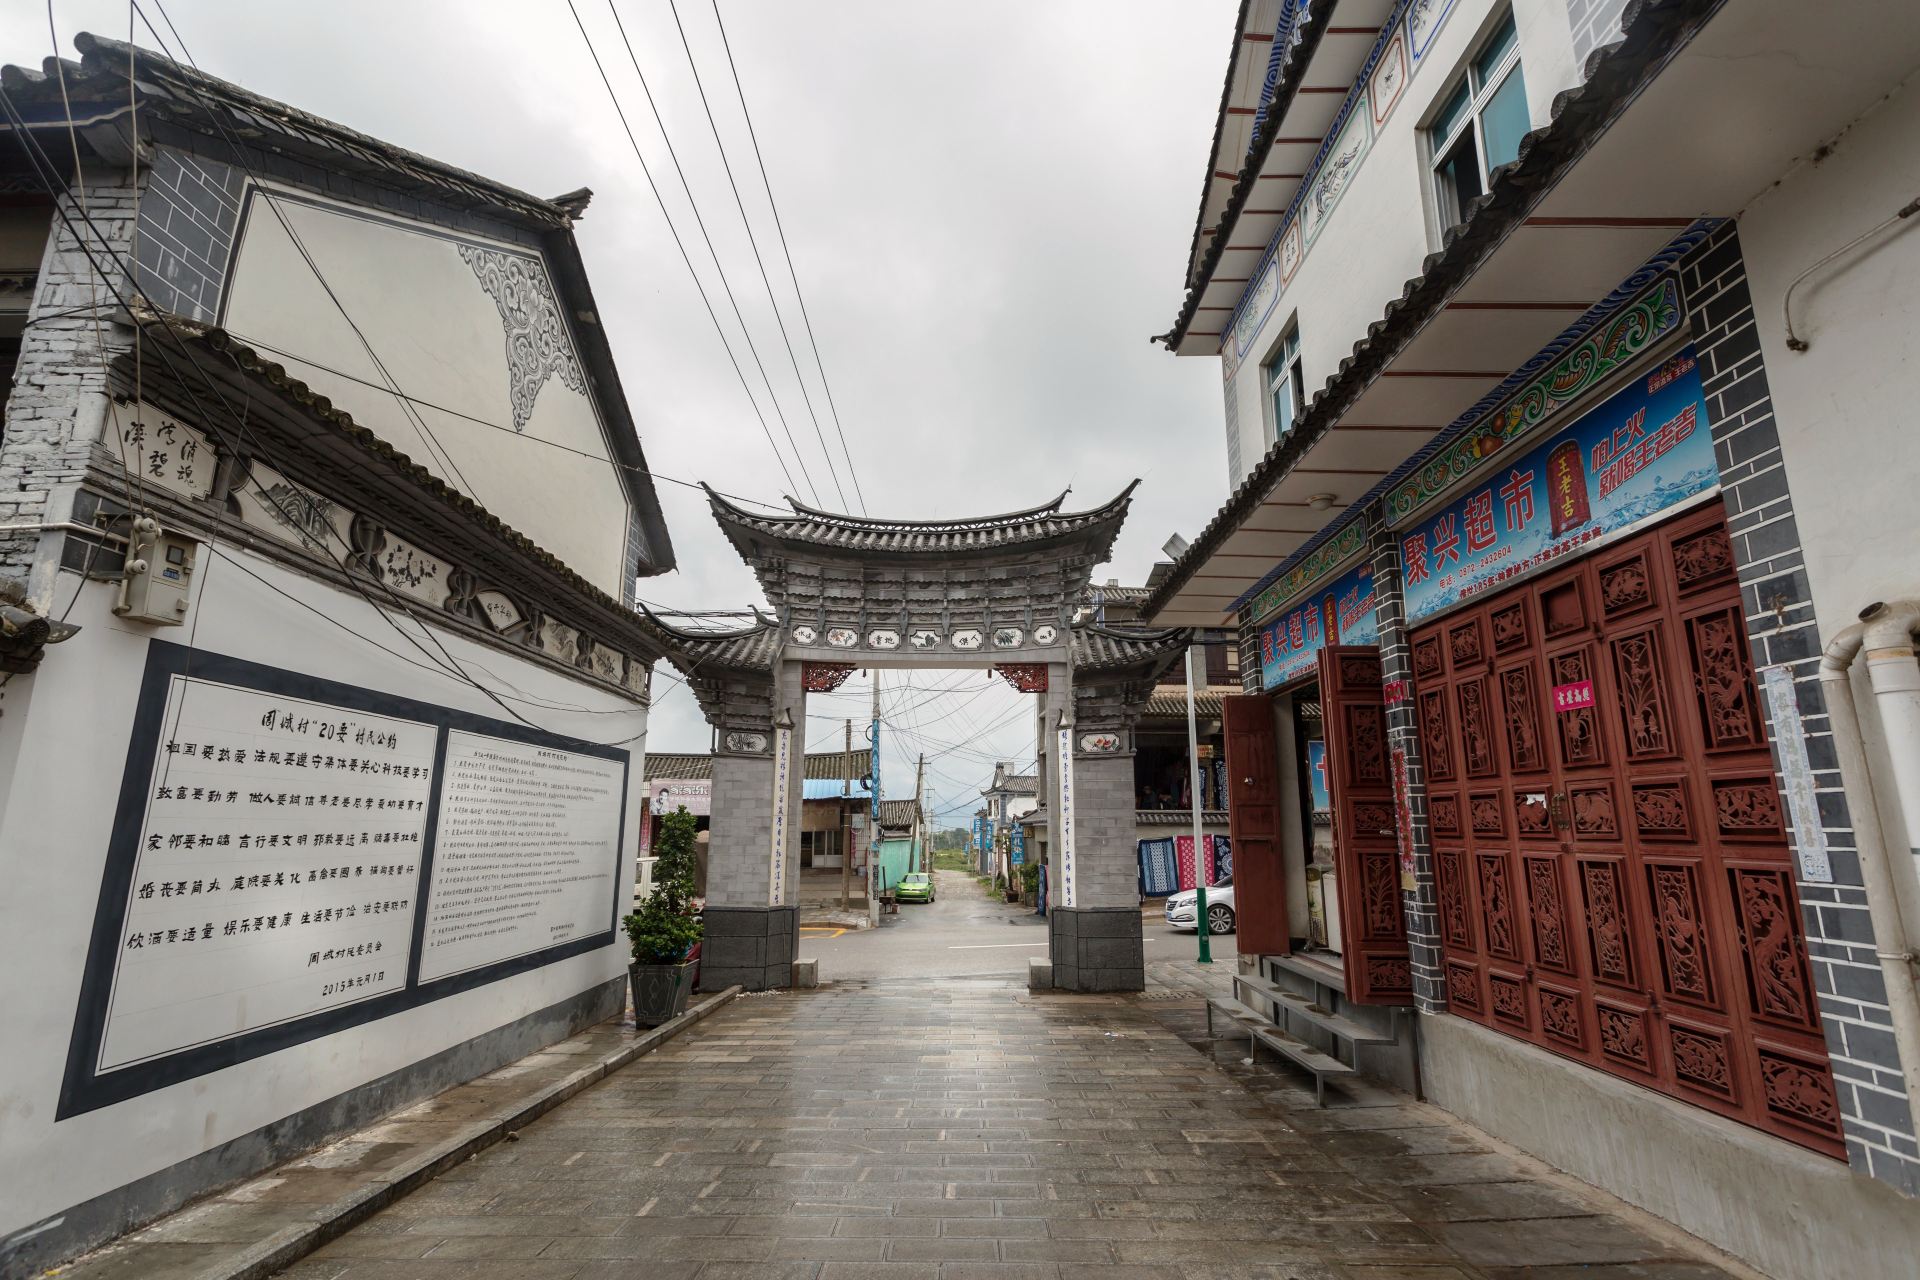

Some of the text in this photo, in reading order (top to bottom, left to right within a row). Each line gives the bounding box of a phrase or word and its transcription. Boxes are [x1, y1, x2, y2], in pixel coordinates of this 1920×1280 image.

[1591, 406, 1647, 474] 怕上火
[1600, 400, 1697, 501] 就喝王老吉
[1557, 456, 1574, 519] 王老吉
[1403, 469, 1535, 588] 聚兴超市
[1262, 602, 1319, 666] 聚兴超市
